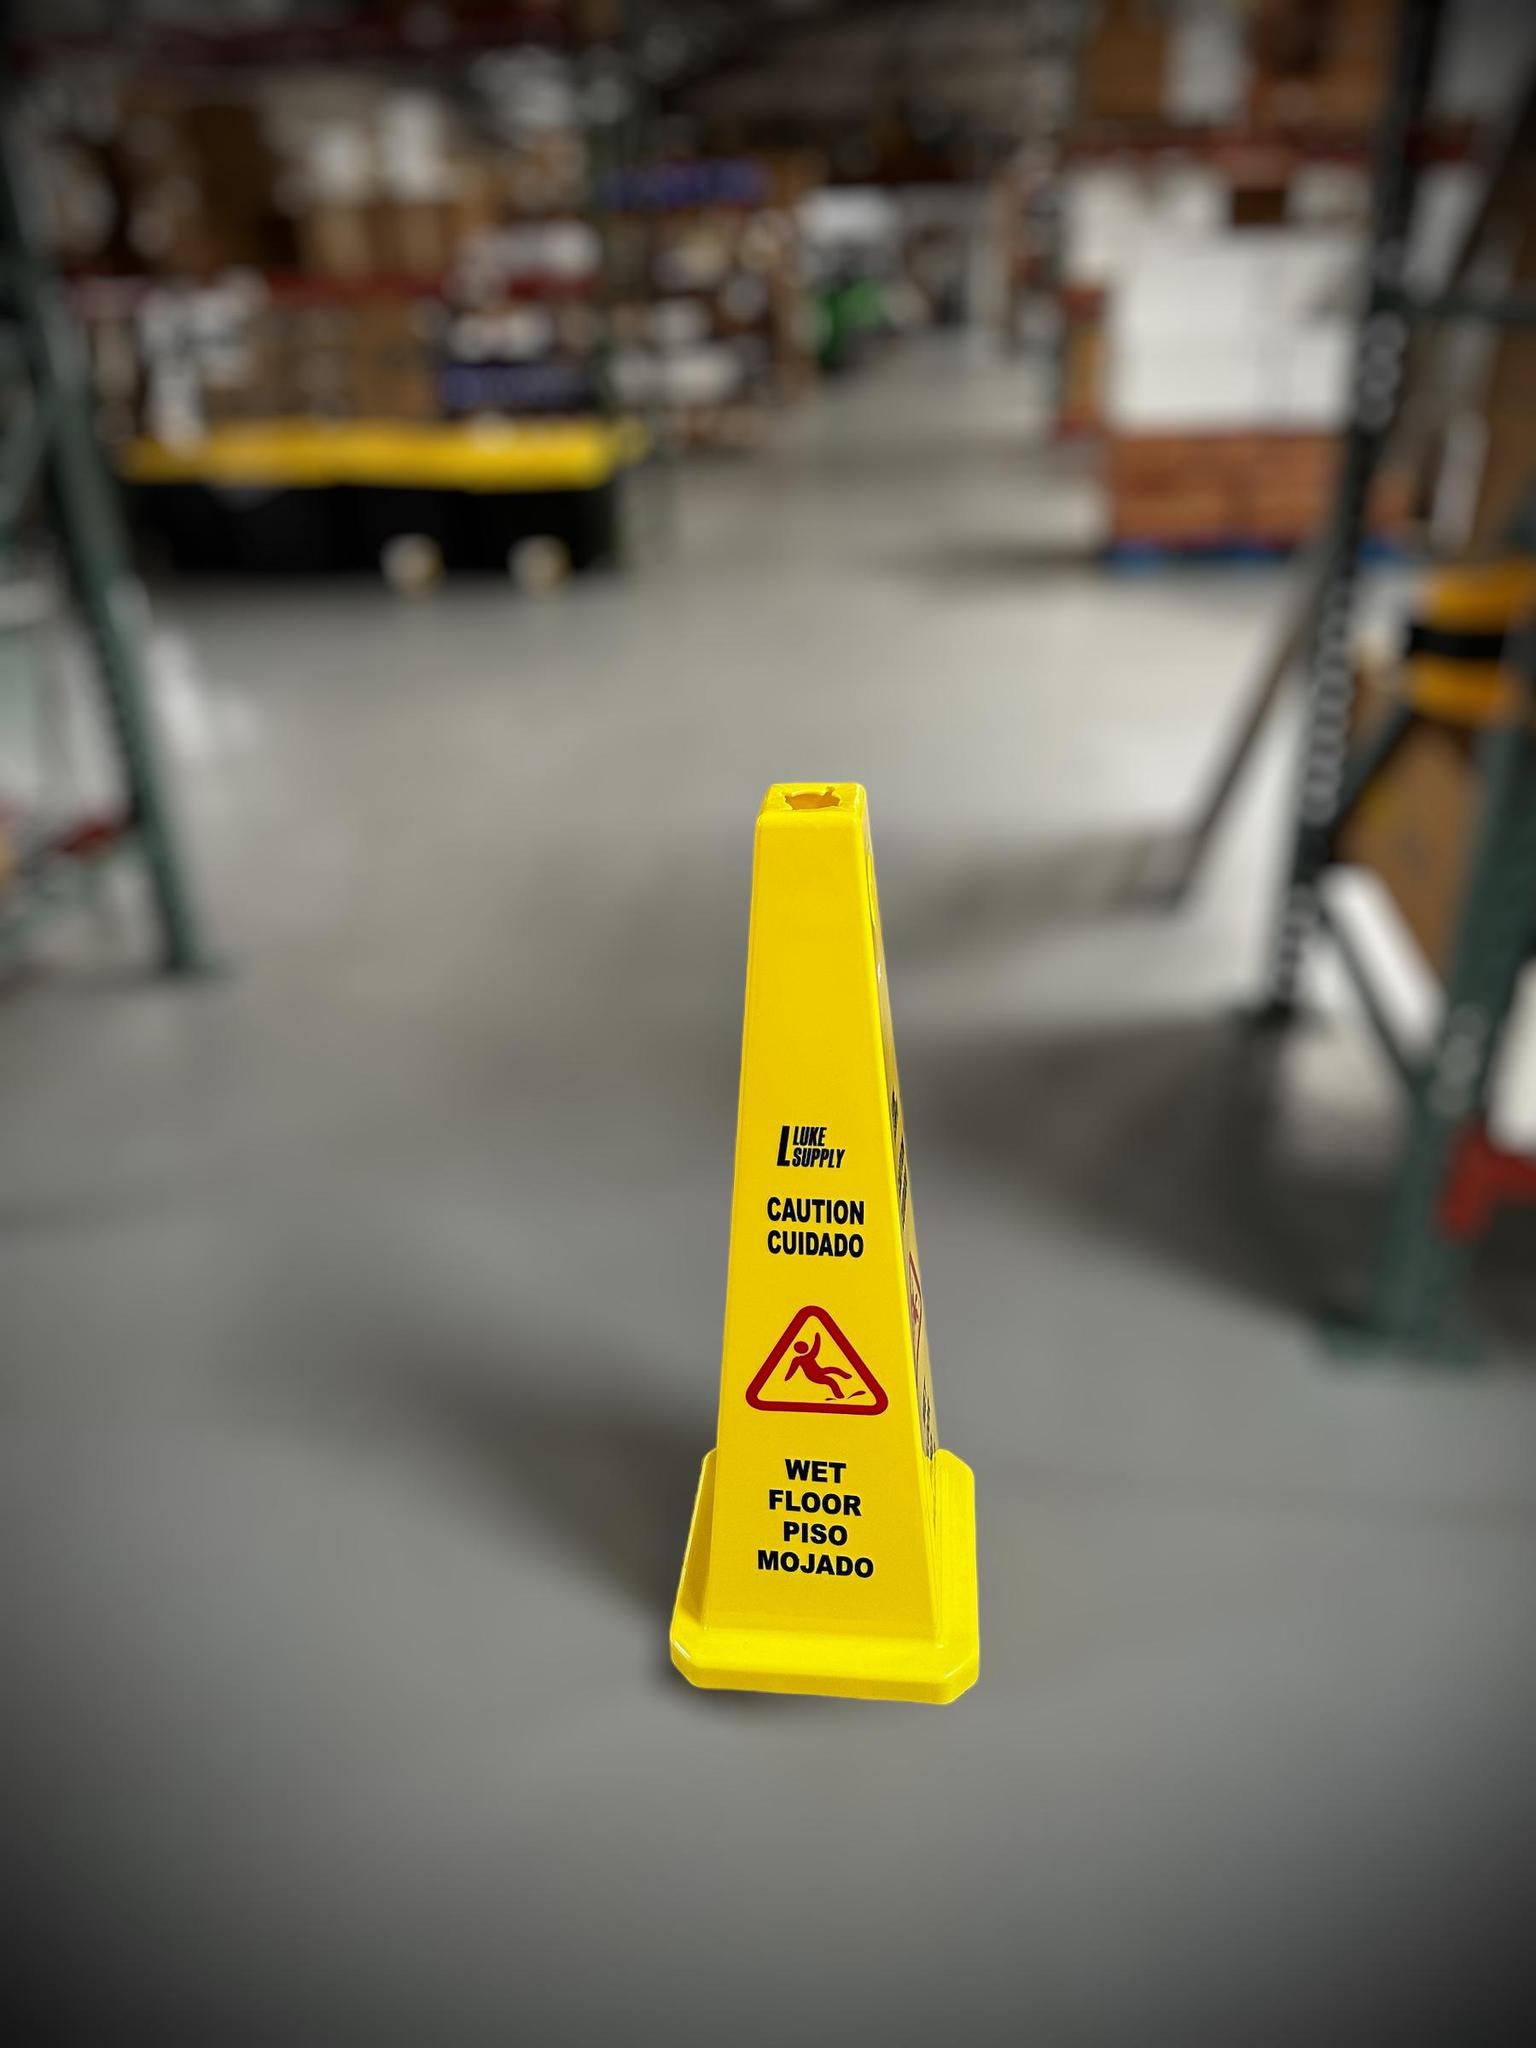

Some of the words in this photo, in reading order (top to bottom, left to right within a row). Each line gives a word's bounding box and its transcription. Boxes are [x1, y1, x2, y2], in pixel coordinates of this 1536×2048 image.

[776, 1125, 791, 1167] L
[793, 1126, 828, 1147] LUKE
[792, 1147, 845, 1169] SUPPLY
[767, 1196, 865, 1225] CAUTION
[767, 1230, 864, 1258] CUIDADO
[785, 1458, 846, 1484] WET
[769, 1489, 861, 1516] FLOOR
[783, 1521, 848, 1546] PISO
[757, 1549, 874, 1578] MOJADO
